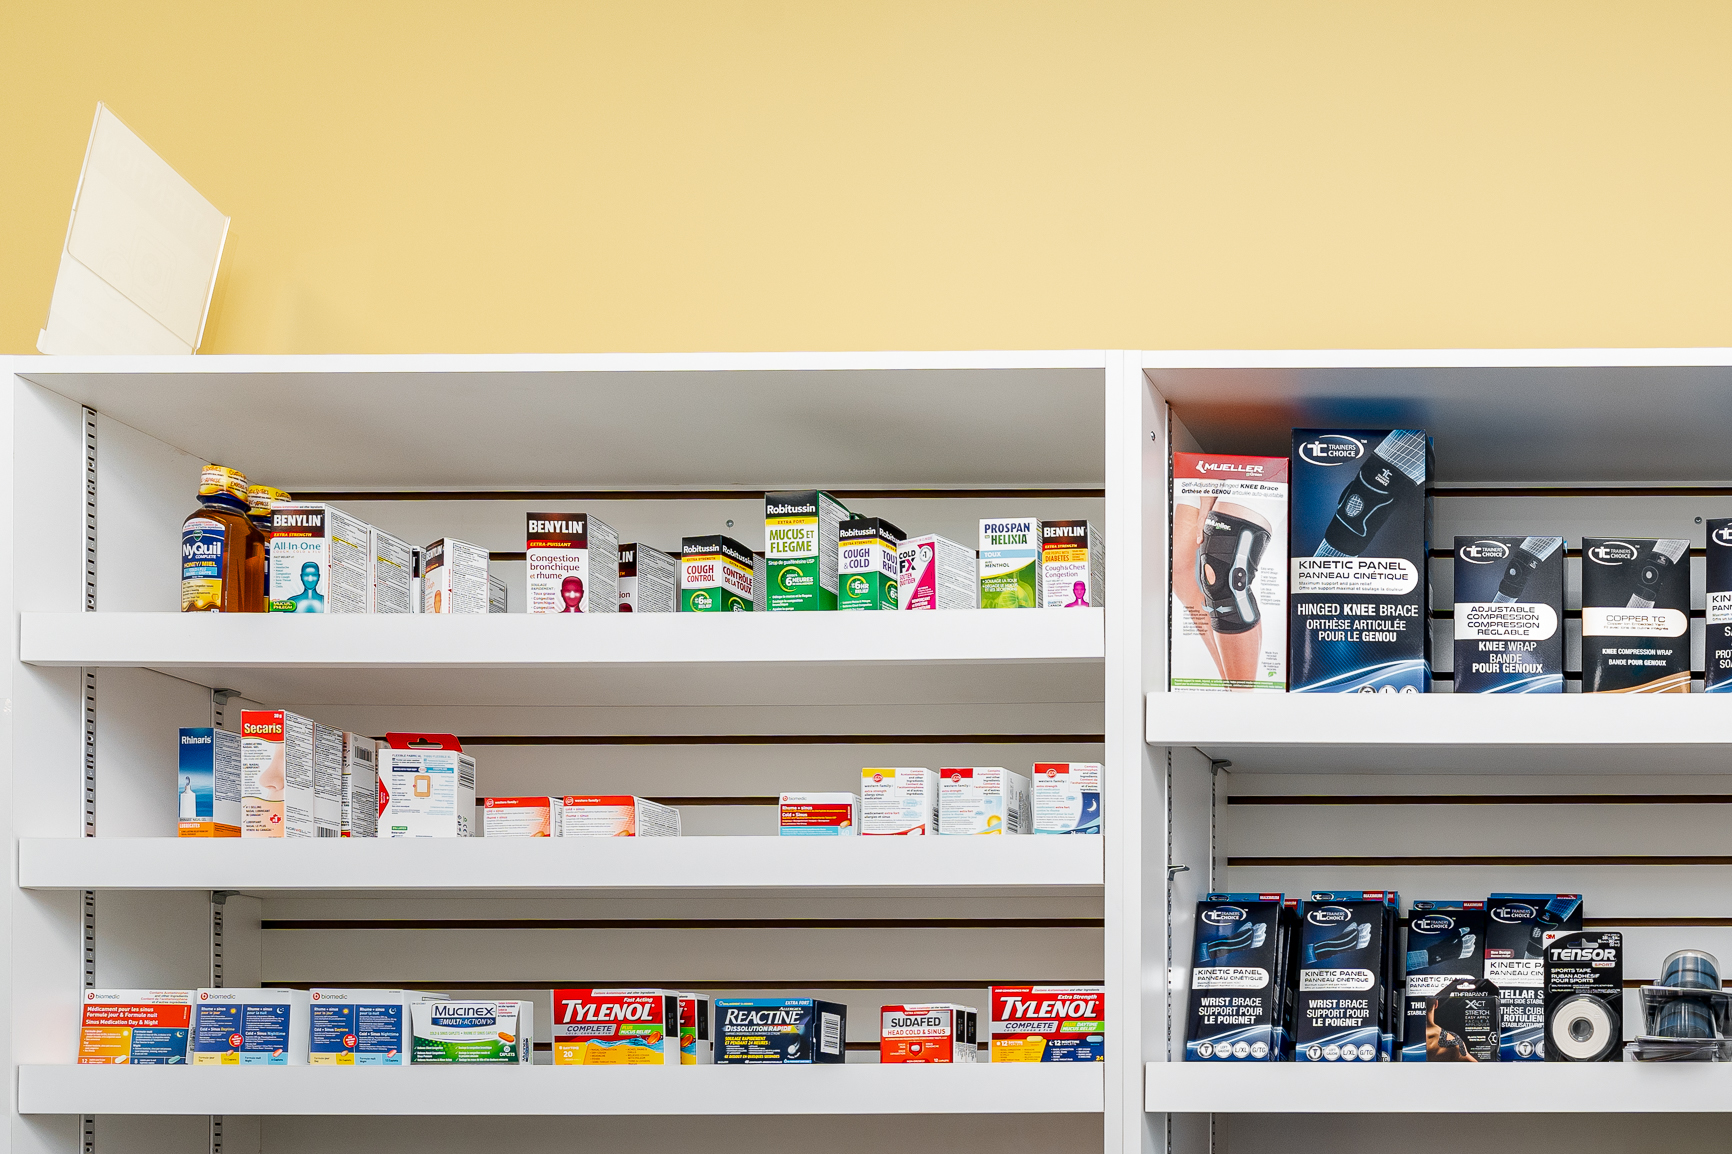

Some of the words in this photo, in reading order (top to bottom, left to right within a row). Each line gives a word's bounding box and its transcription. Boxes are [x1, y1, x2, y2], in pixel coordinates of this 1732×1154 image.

[1204, 464, 1263, 473] MUELLER
[767, 503, 816, 515] Robitussin
[273, 515, 323, 527] BENYLIN
[528, 520, 583, 534] BENYLIN
[769, 529, 801, 541] MUCUS
[804, 530, 814, 538] ET
[984, 523, 1031, 535] PROSPAN
[990, 533, 1028, 545] HELIXIA
[770, 541, 811, 554] FLEGME
[530, 554, 579, 564] Congestion
[530, 562, 580, 572] bronchique
[1299, 561, 1354, 570] KINETIC
[1359, 562, 1406, 570] PANEL
[1353, 571, 1408, 580] CINÉTIQUE
[1298, 604, 1339, 616] HINGED
[1344, 604, 1376, 616] KNEE
[1380, 605, 1418, 616] BRACE
[1306, 618, 1350, 629] ORTHÈSE
[1353, 618, 1406, 630] ARTICULÉE
[1319, 631, 1345, 641] POUR
[1348, 632, 1359, 641] LE
[1362, 632, 1396, 641] GENOU
[1479, 642, 1505, 652] KNEE
[1508, 642, 1537, 652] WRAP
[244, 722, 282, 734] Secaris
[181, 735, 212, 744] Rhinaris
[1552, 949, 1615, 961] TENSOR
[1201, 998, 1230, 1007] WRIST
[1233, 999, 1262, 1007] BRACE
[435, 1005, 493, 1016] Mucinex
[562, 1000, 653, 1023] TYLENOL
[725, 1009, 804, 1024] REACTINE
[442, 1018, 487, 1026] MULTI-ACTION
[891, 1016, 941, 1028] SUDAFED
